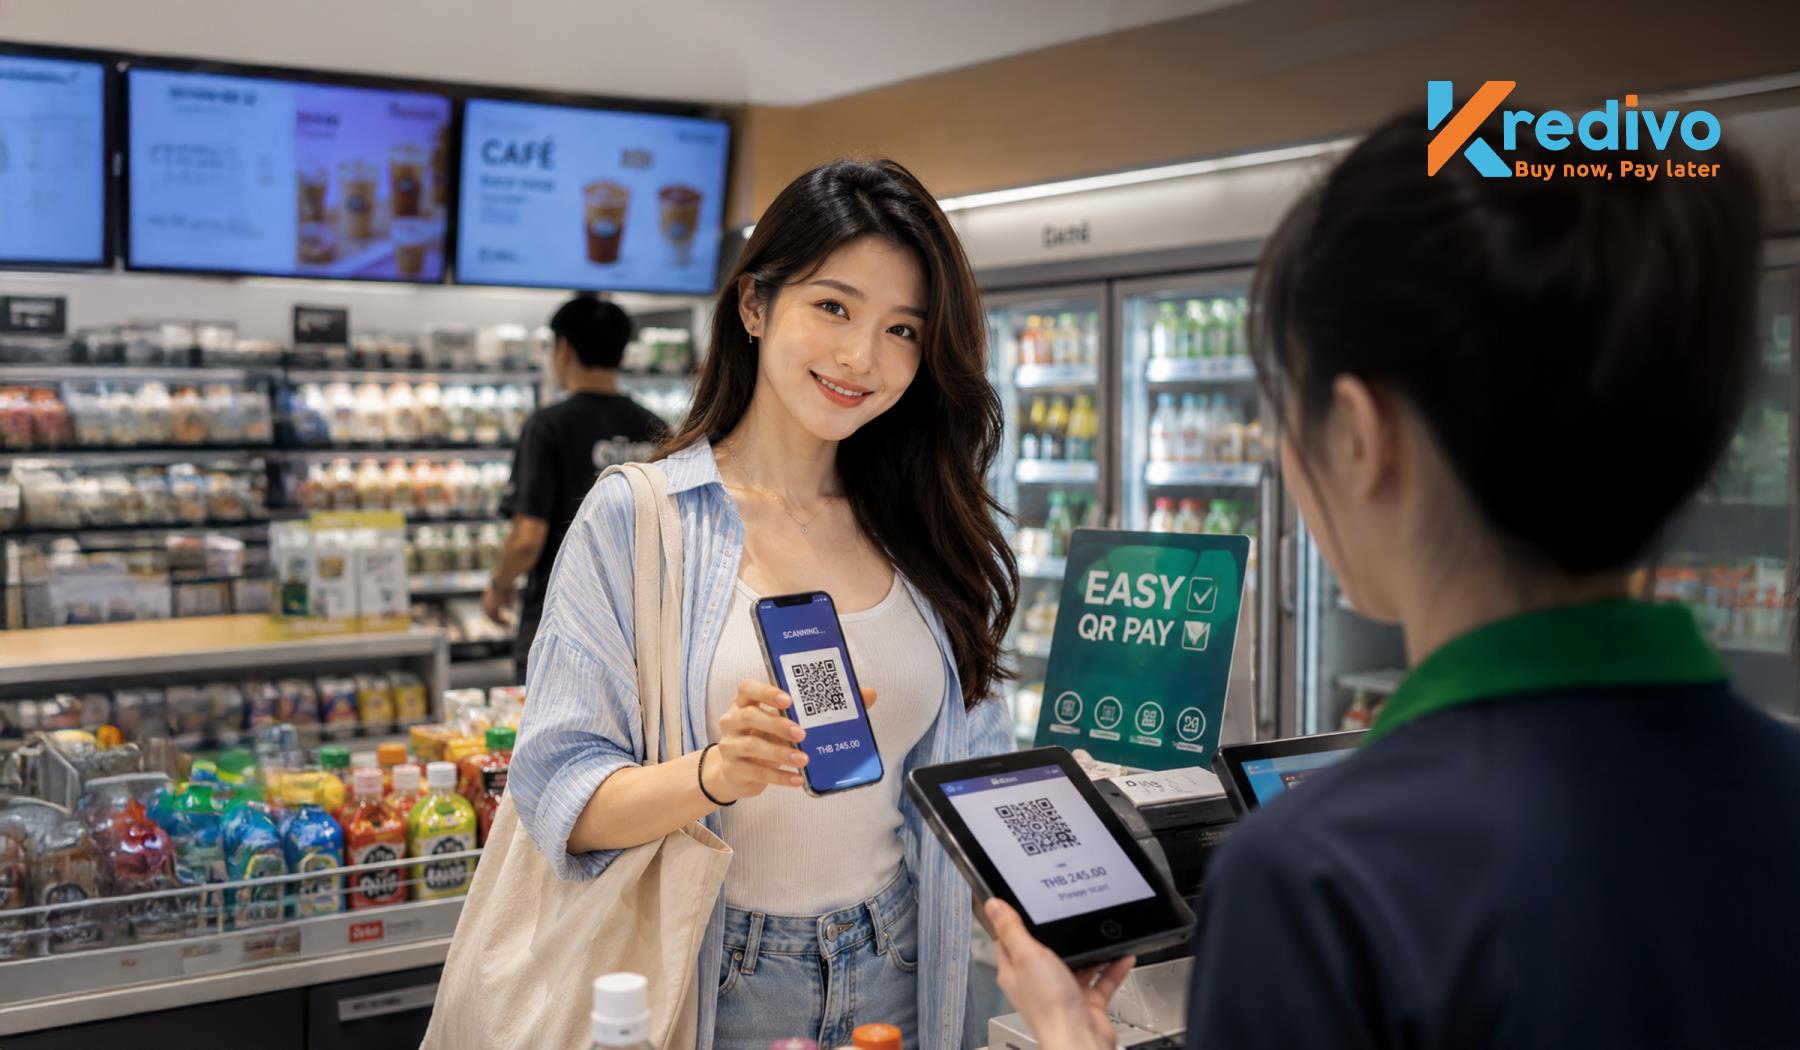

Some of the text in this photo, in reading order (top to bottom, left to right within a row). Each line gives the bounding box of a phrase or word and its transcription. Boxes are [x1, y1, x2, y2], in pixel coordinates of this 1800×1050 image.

[480, 135, 556, 169] CAFÉ
[1084, 570, 1186, 610] EASY
[1078, 613, 1175, 647] QR PAY
[816, 740, 860, 755] THB 245.00
[1041, 866, 1106, 888] THB 245.00
